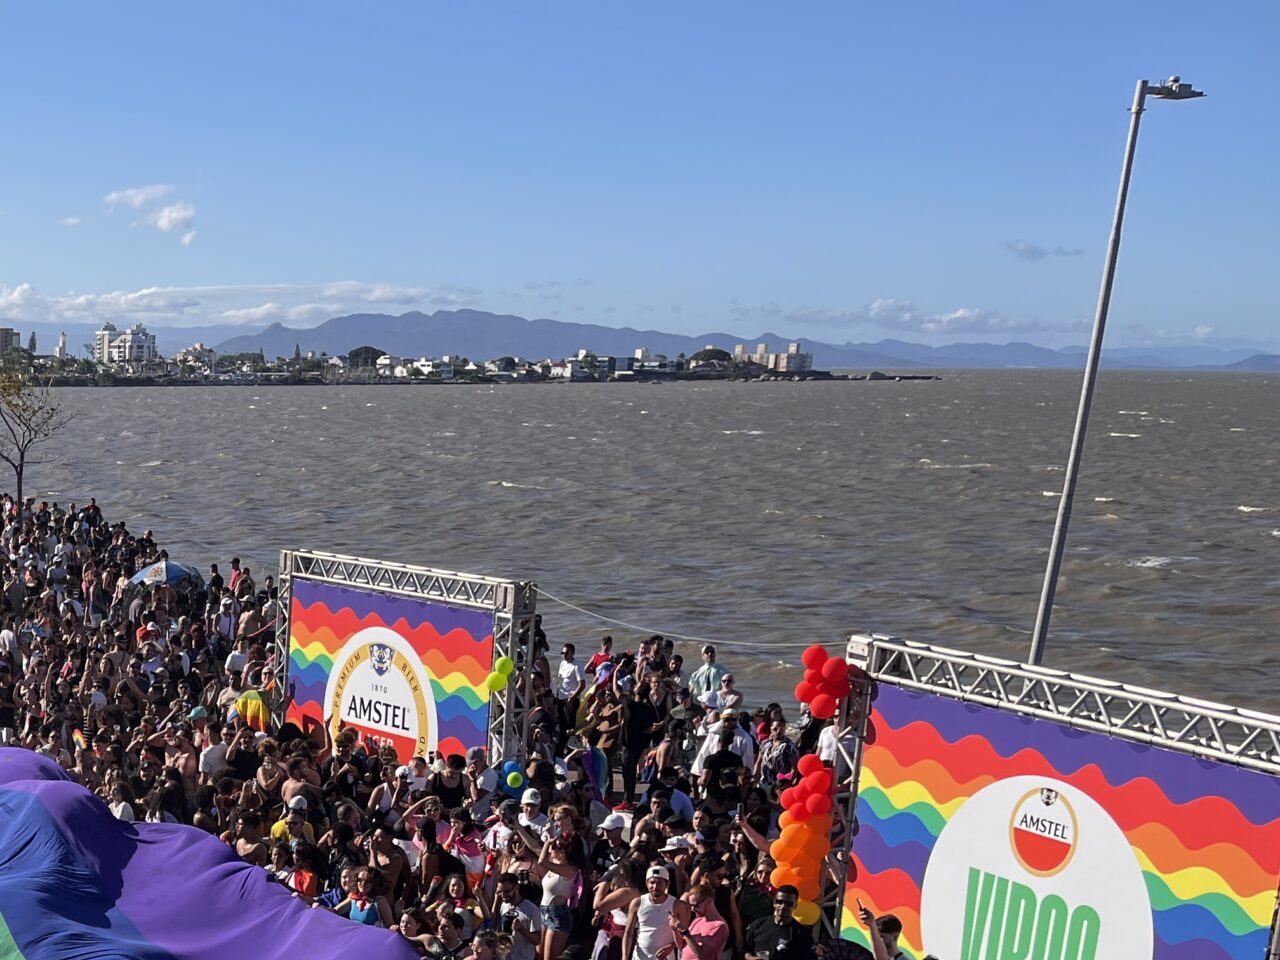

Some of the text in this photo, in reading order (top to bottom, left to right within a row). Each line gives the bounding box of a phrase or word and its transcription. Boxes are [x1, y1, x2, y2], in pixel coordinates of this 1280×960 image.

[333, 652, 419, 709] PREMIUM BIER
[371, 683, 388, 694] 1870
[347, 695, 410, 732] AMSTEL
[1019, 813, 1068, 840] AMSTEL
